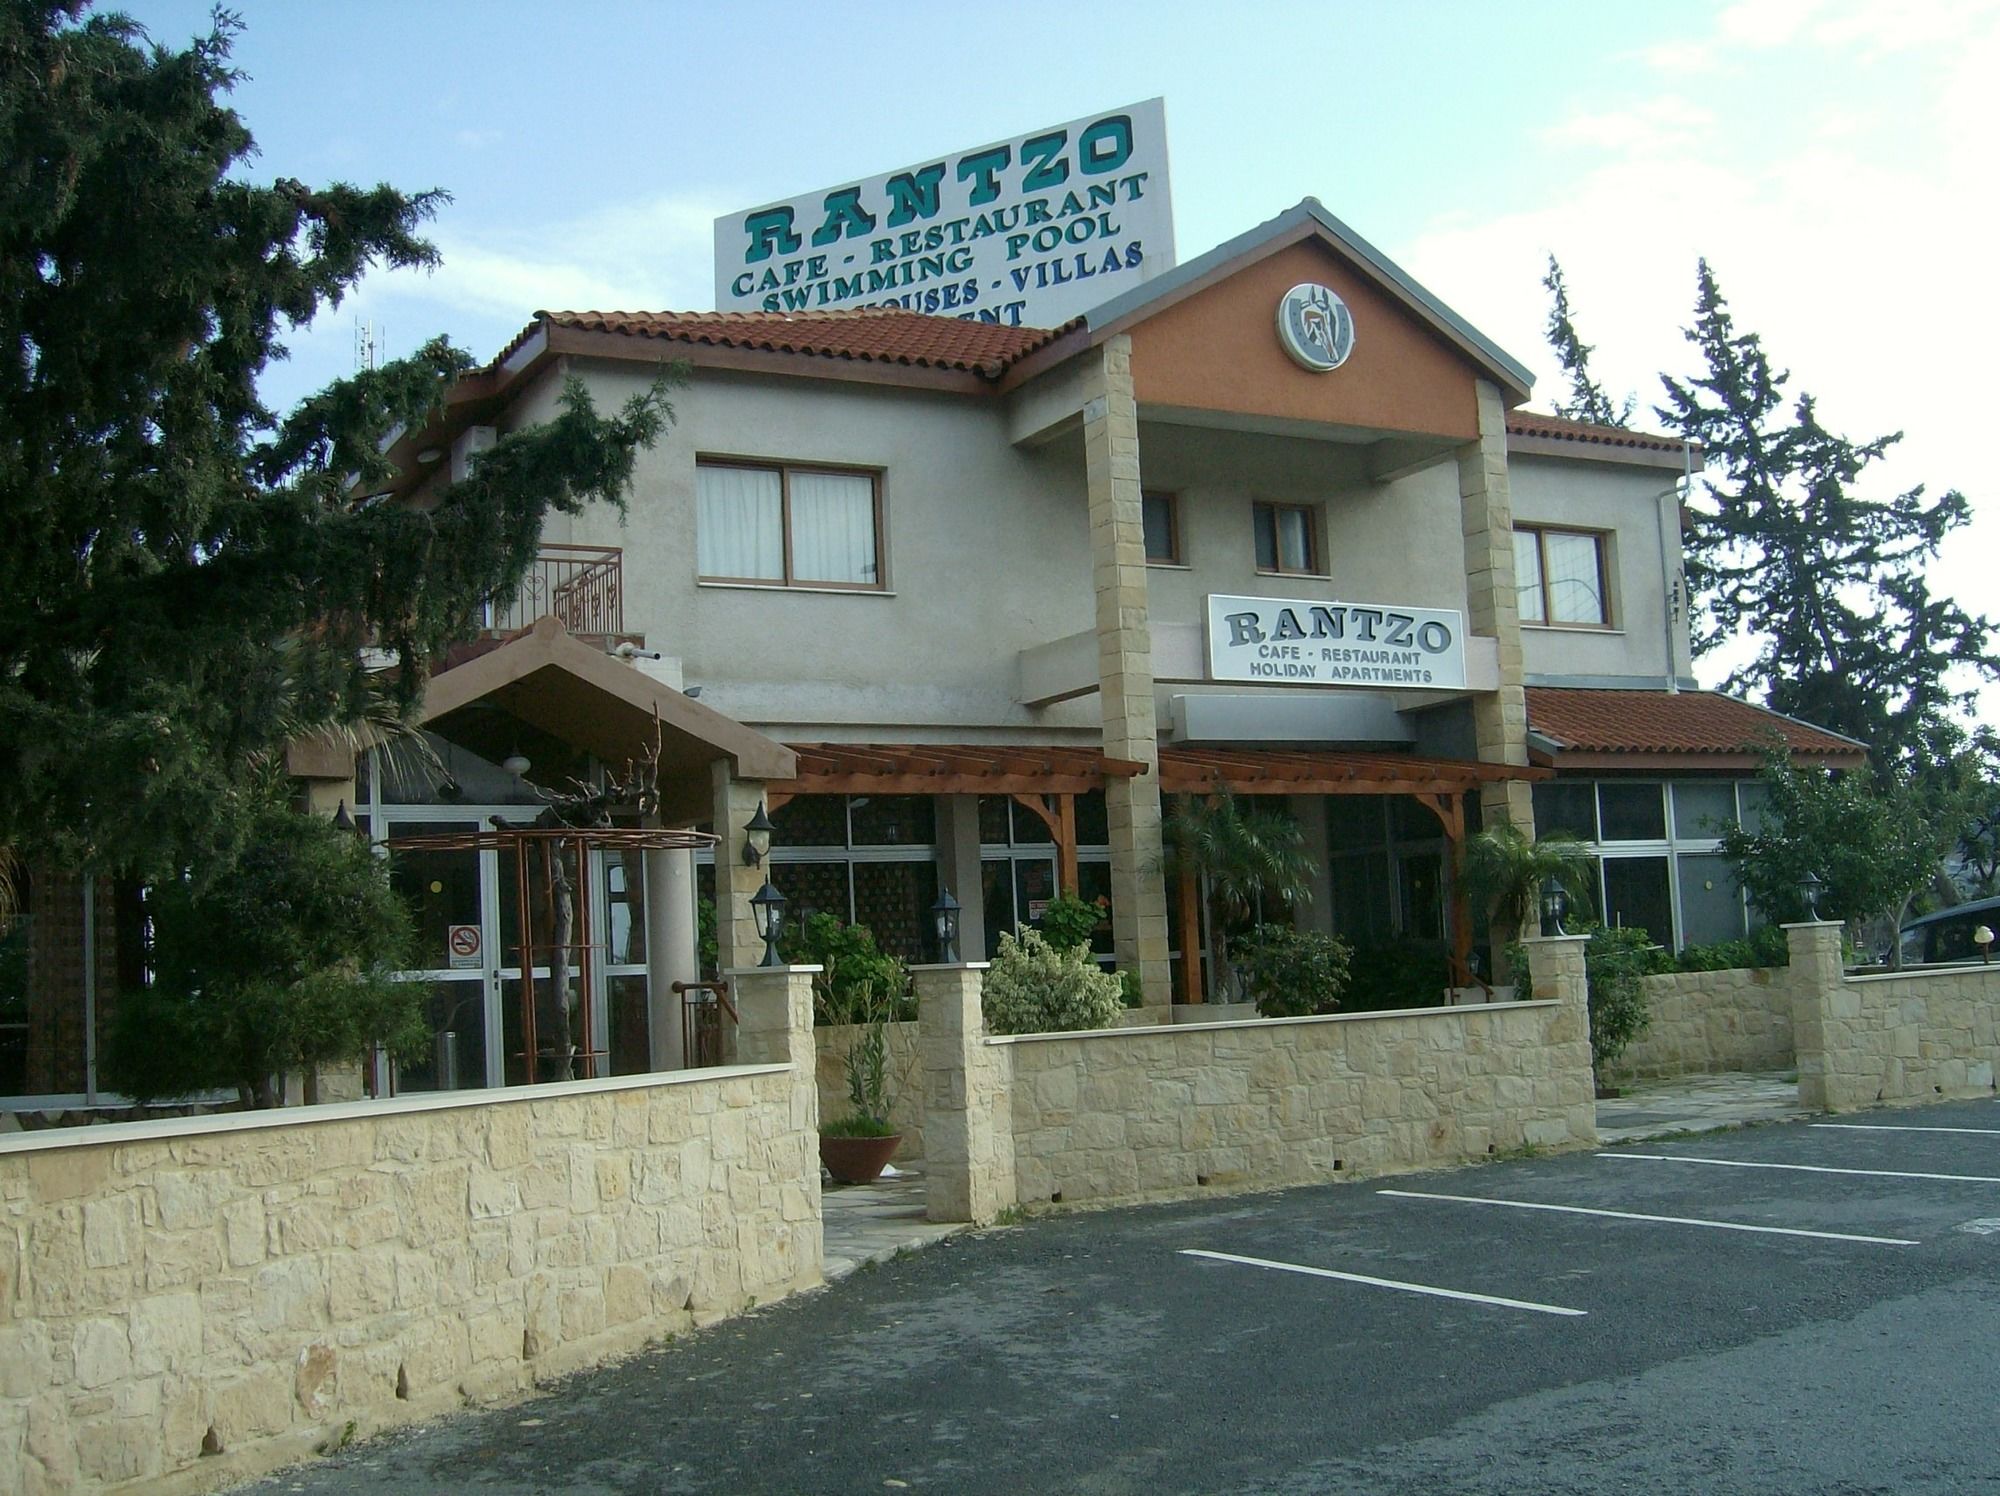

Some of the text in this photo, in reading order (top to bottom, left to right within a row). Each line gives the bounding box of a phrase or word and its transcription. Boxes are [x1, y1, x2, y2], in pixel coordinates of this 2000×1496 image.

[744, 114, 1134, 264] RANTZO
[731, 254, 829, 298] CAFE
[870, 172, 1149, 266] RESTAURANT
[762, 212, 1121, 313] SWIMMING POOL
[1010, 241, 1143, 293] VILLAS
[957, 300, 1026, 327] NT
[1224, 606, 1452, 654] RANTZO
[1258, 644, 1300, 660] CAFE
[1321, 648, 1421, 666] RESTAURANT
[1250, 663, 1433, 683] HOLIDAY APARTMENTS
